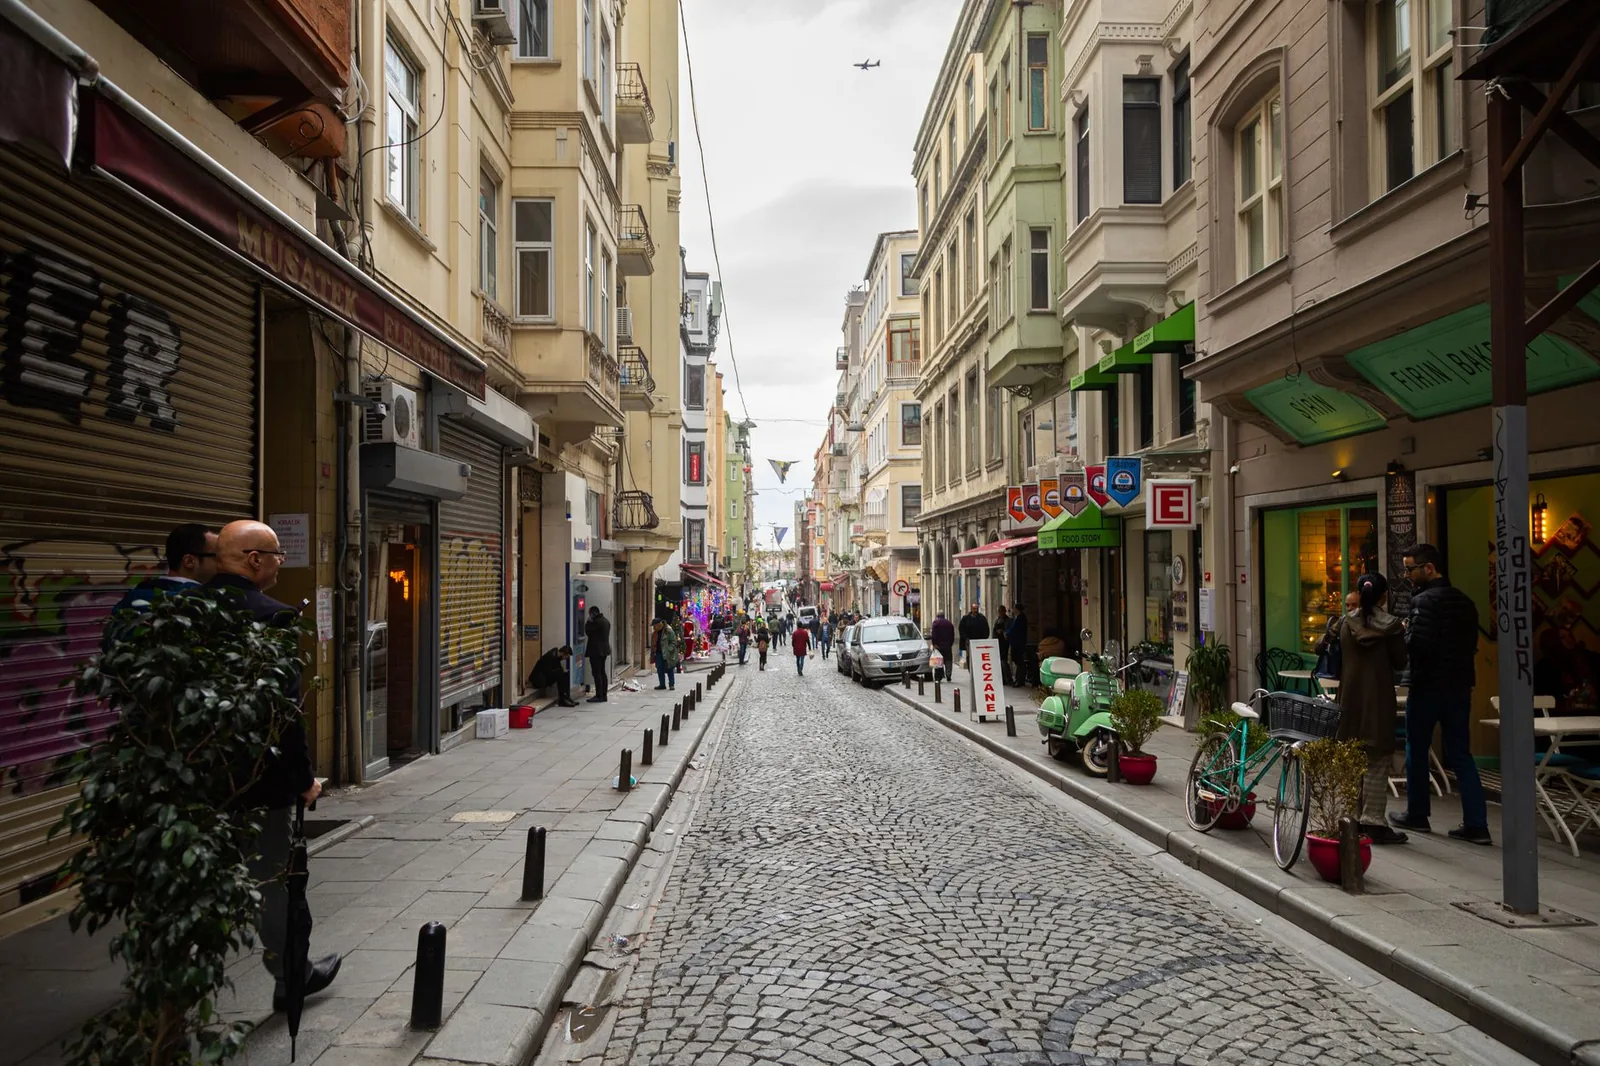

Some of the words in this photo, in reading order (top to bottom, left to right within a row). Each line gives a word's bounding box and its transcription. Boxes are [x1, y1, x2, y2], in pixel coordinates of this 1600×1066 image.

[1390, 360, 1452, 392] FIRIN
[1161, 490, 1184, 519] E
[1062, 535, 1080, 543] FOOD
[1081, 534, 1101, 543] STORY
[981, 653, 996, 712] ECZANE
